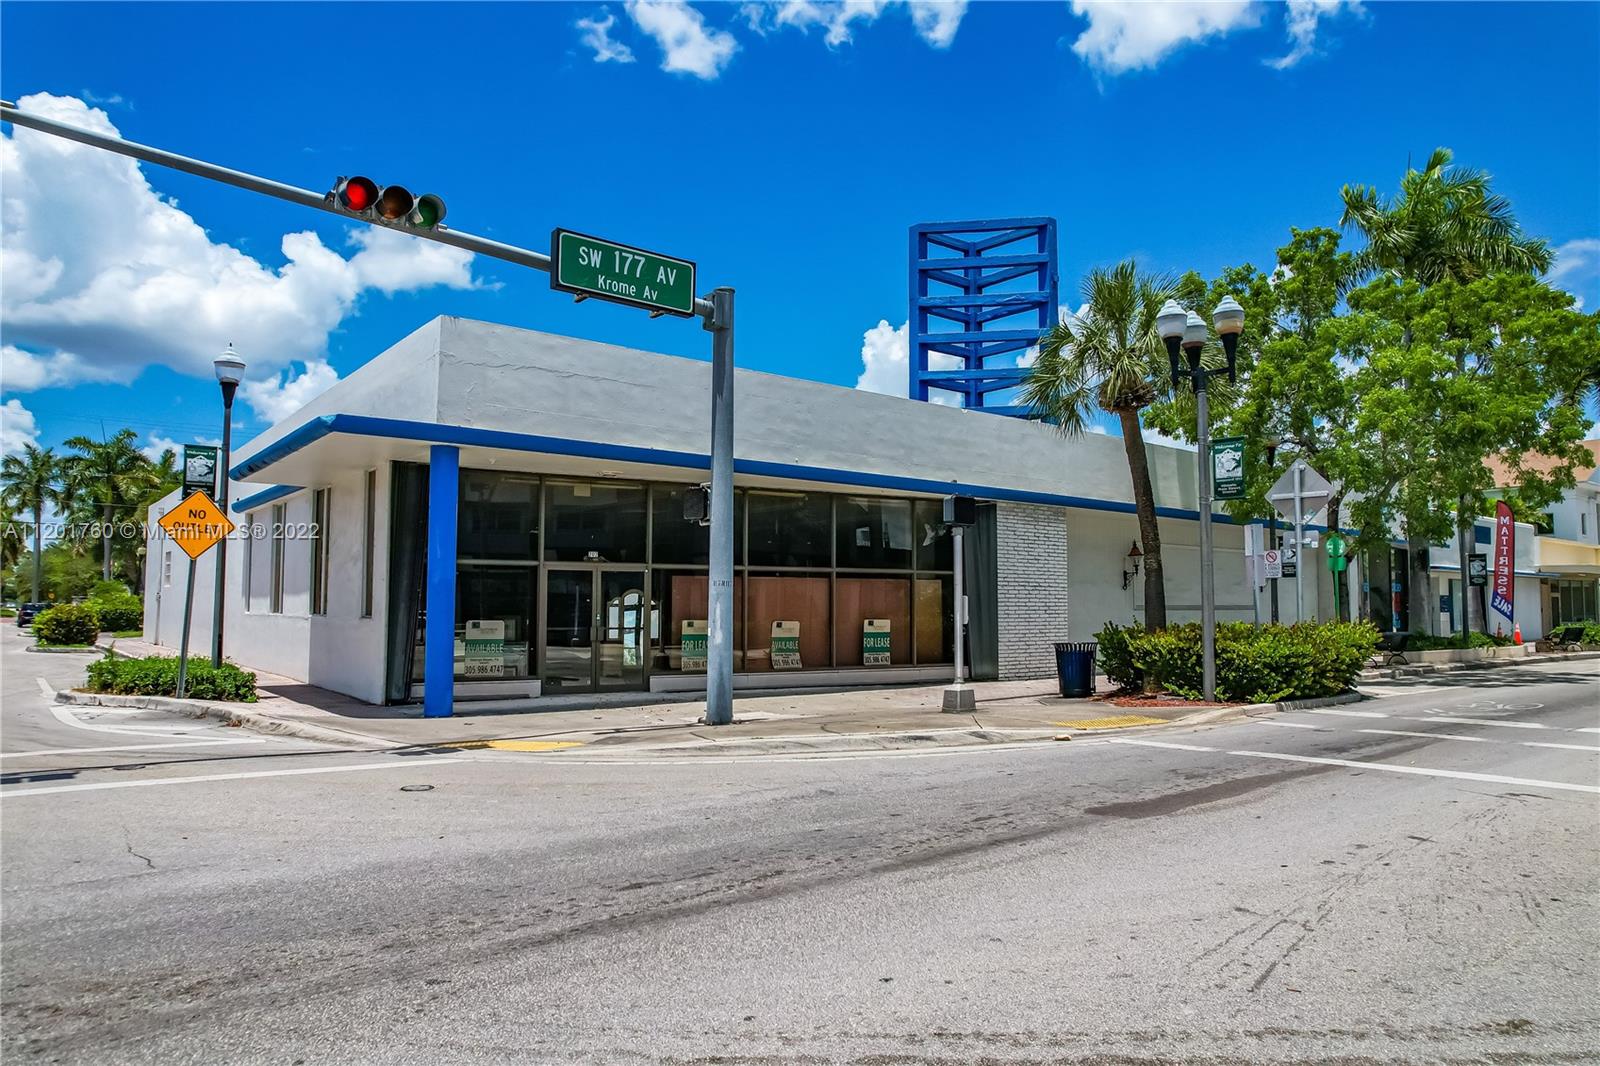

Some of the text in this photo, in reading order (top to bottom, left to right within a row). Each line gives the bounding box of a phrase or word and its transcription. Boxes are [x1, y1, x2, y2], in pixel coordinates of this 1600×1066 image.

[579, 246, 677, 286] SW 177 AV
[598, 275, 658, 301] Krome Av
[188, 509, 207, 520] NO
[173, 521, 219, 534] OUTLET
[466, 643, 504, 653] AVAILABLE
[682, 640, 708, 651] FOR LEA
[771, 640, 799, 650] AVAILABLE
[864, 637, 890, 648] FOR LEASE
